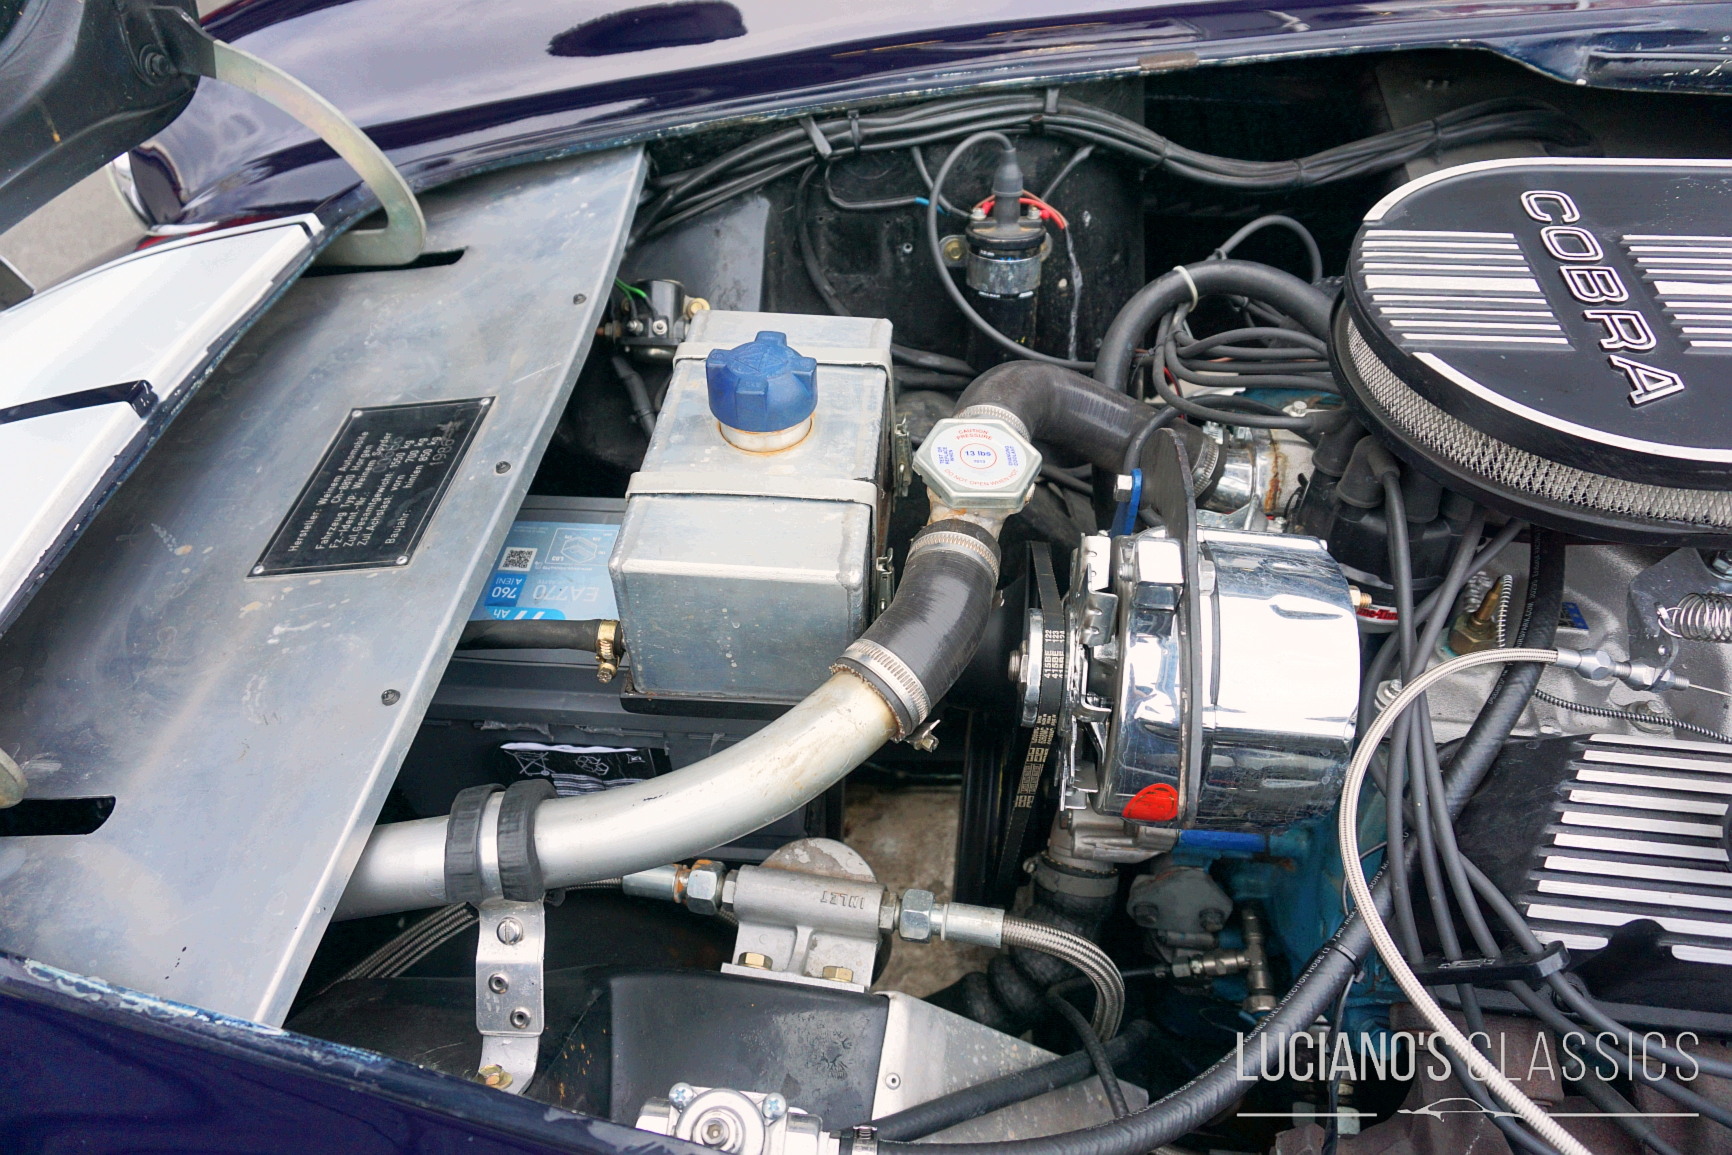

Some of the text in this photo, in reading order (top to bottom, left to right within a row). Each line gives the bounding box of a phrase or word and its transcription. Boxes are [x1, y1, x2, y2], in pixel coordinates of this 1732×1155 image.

[1520, 190, 1685, 405] COBRA
[330, 444, 374, 503] Ch-8810 Horgen
[389, 452, 405, 467] 1550
[400, 439, 414, 448] kg
[390, 474, 404, 490] vorn
[404, 449, 418, 462] 700
[414, 437, 428, 446] kg
[403, 436, 441, 488] hinten 850 kg
[288, 431, 369, 551] Hersteller: Weinem Automobile
[315, 431, 394, 549] Fahrzeug Typ: Weinem Spyder
[944, 468, 954, 477] DO
[953, 475, 968, 483] NOT
[989, 477, 1009, 485] WHEN
[1008, 469, 1019, 478] HOT
[385, 509, 413, 543] Baujahr:
[491, 586, 518, 599] 760
[493, 609, 511, 619] Ah
[532, 584, 600, 602] EA770
[820, 890, 865, 909] INLET
[1244, 1021, 1267, 1044] RACING
[1264, 1006, 1283, 1022] FUEL
[1280, 972, 1310, 1006] INJECTION
[1307, 953, 1325, 973] HOSE
